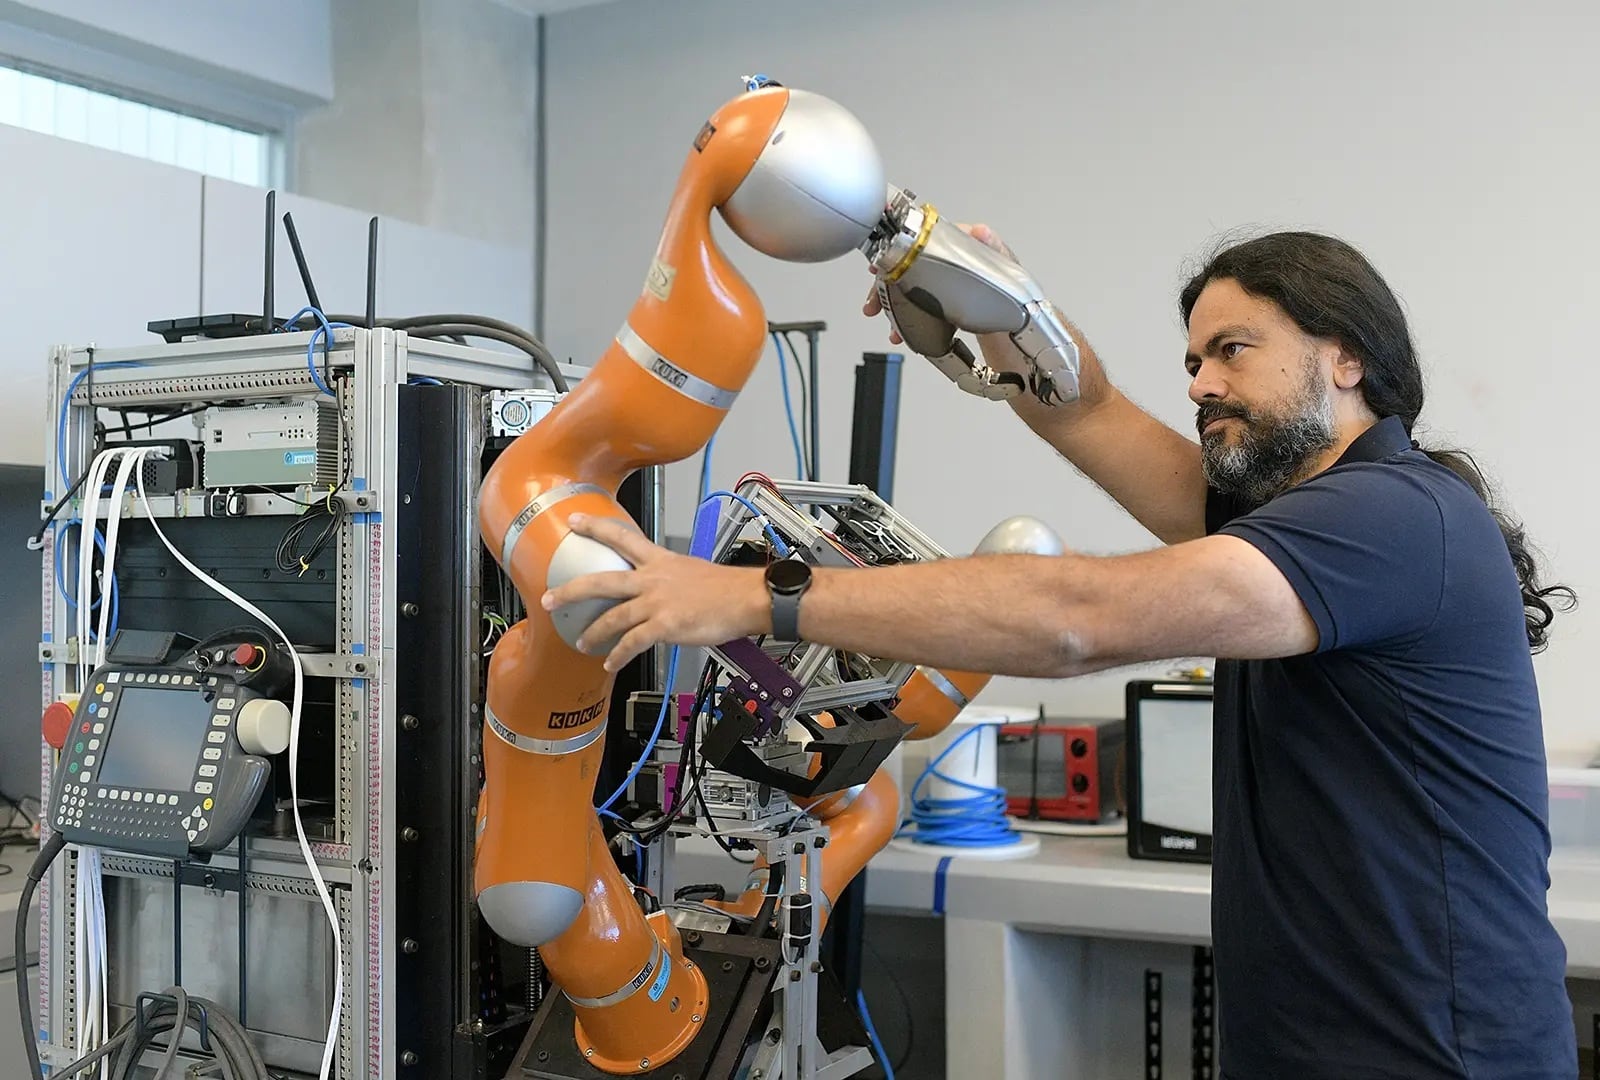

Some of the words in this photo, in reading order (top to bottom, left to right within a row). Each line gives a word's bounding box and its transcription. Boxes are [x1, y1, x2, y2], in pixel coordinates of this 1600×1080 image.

[652, 359, 687, 388] KUKA
[514, 502, 541, 531] KUKA
[549, 699, 605, 728] KUKA
[493, 720, 516, 744] KUKA
[632, 961, 653, 988] KUKA
